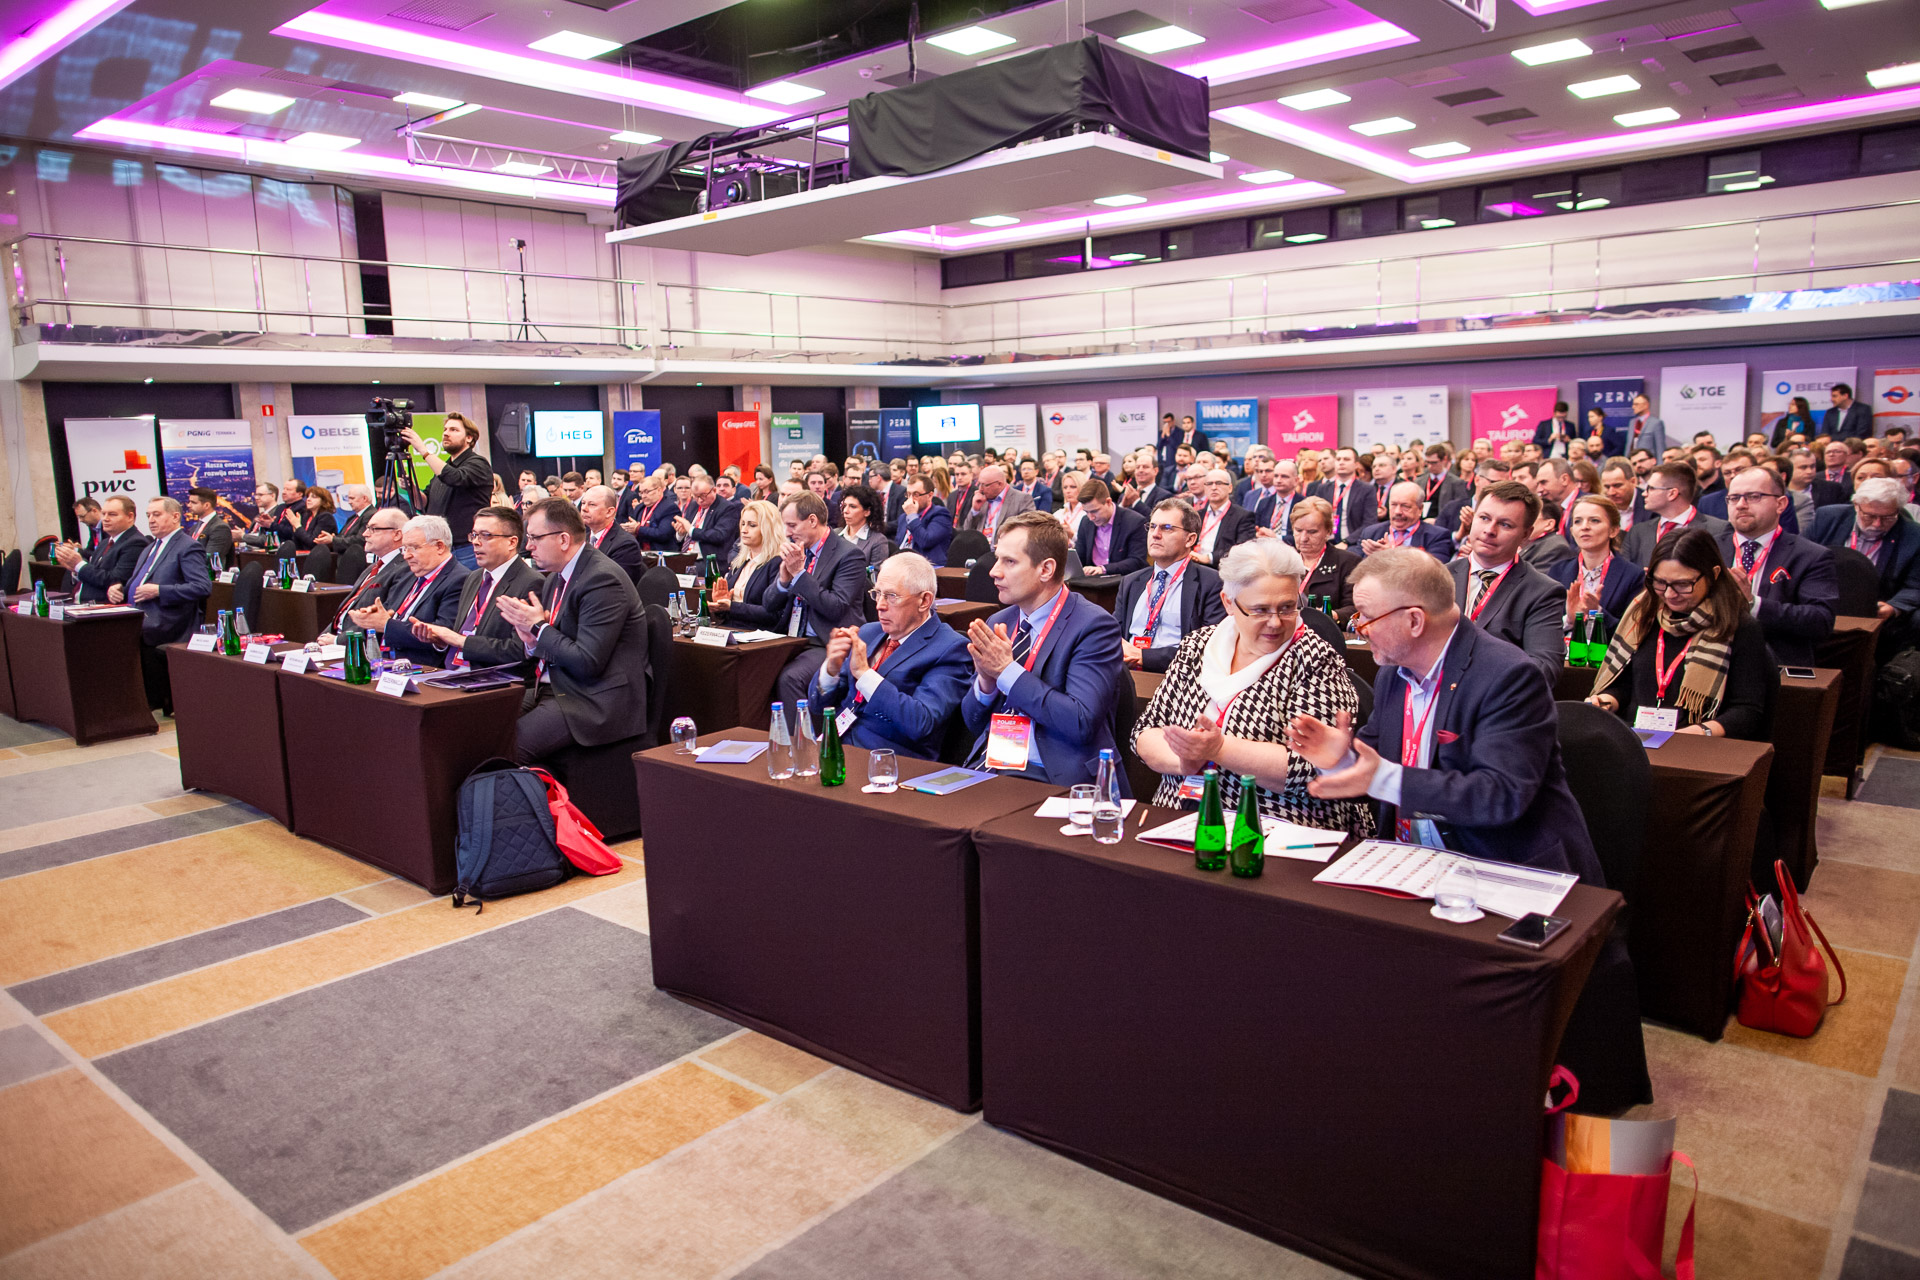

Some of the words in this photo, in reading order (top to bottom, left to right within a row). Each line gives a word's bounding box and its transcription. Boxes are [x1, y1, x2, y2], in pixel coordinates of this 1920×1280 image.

[1699, 385, 1726, 397] TGE
[1795, 382, 1845, 392] BELS
[1202, 404, 1251, 419] INNSOFT
[1129, 413, 1145, 421] TGE
[889, 418, 911, 428] PERN
[318, 427, 360, 437] BELSE
[994, 424, 1026, 435] PSE
[561, 430, 592, 440] HEG
[627, 434, 653, 444] Enea
[1281, 432, 1324, 444] TAURON
[224, 461, 248, 469] energia
[82, 479, 136, 497] pwc
